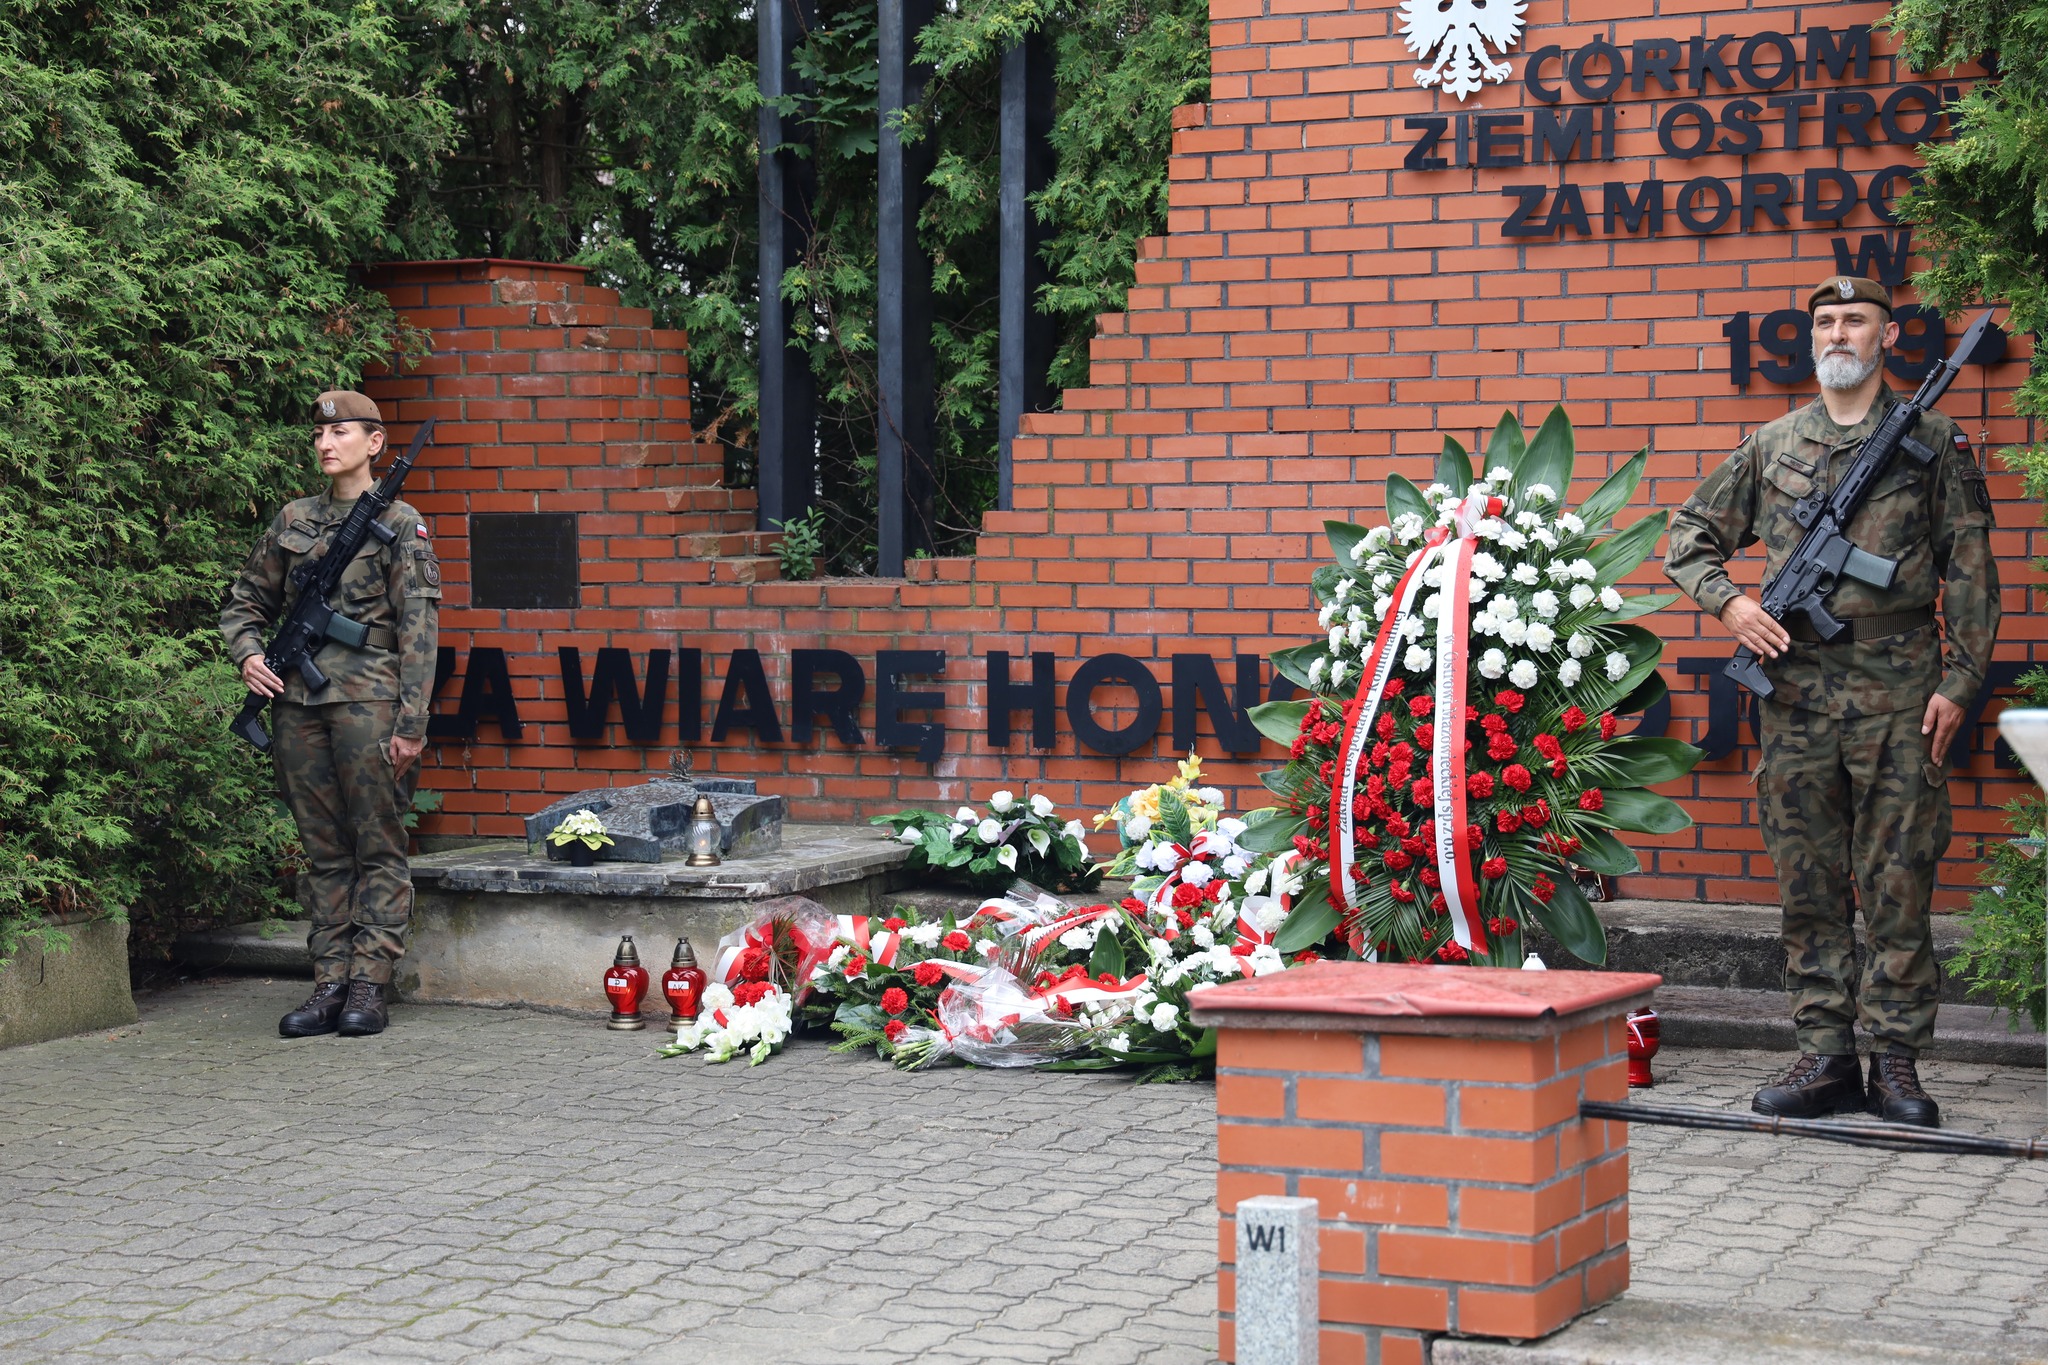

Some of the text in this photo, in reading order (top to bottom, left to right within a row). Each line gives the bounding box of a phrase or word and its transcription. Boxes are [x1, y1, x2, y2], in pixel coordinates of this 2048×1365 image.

[1524, 23, 1871, 103] CÓRKOM
[1403, 84, 1966, 171] ZIEMI OSTRO
[1500, 164, 1928, 238] ZAMORDO
[1722, 304, 1945, 386] 199
[557, 646, 947, 764] WIARĘ
[986, 649, 1312, 755] HON
[1442, 650, 1459, 705] Ostrowi
[1335, 609, 1406, 835] Zakład Gospodarki Komunalnej
[1437, 707, 1459, 802] Mazowieckiej
[1245, 1223, 1286, 1254] W1
